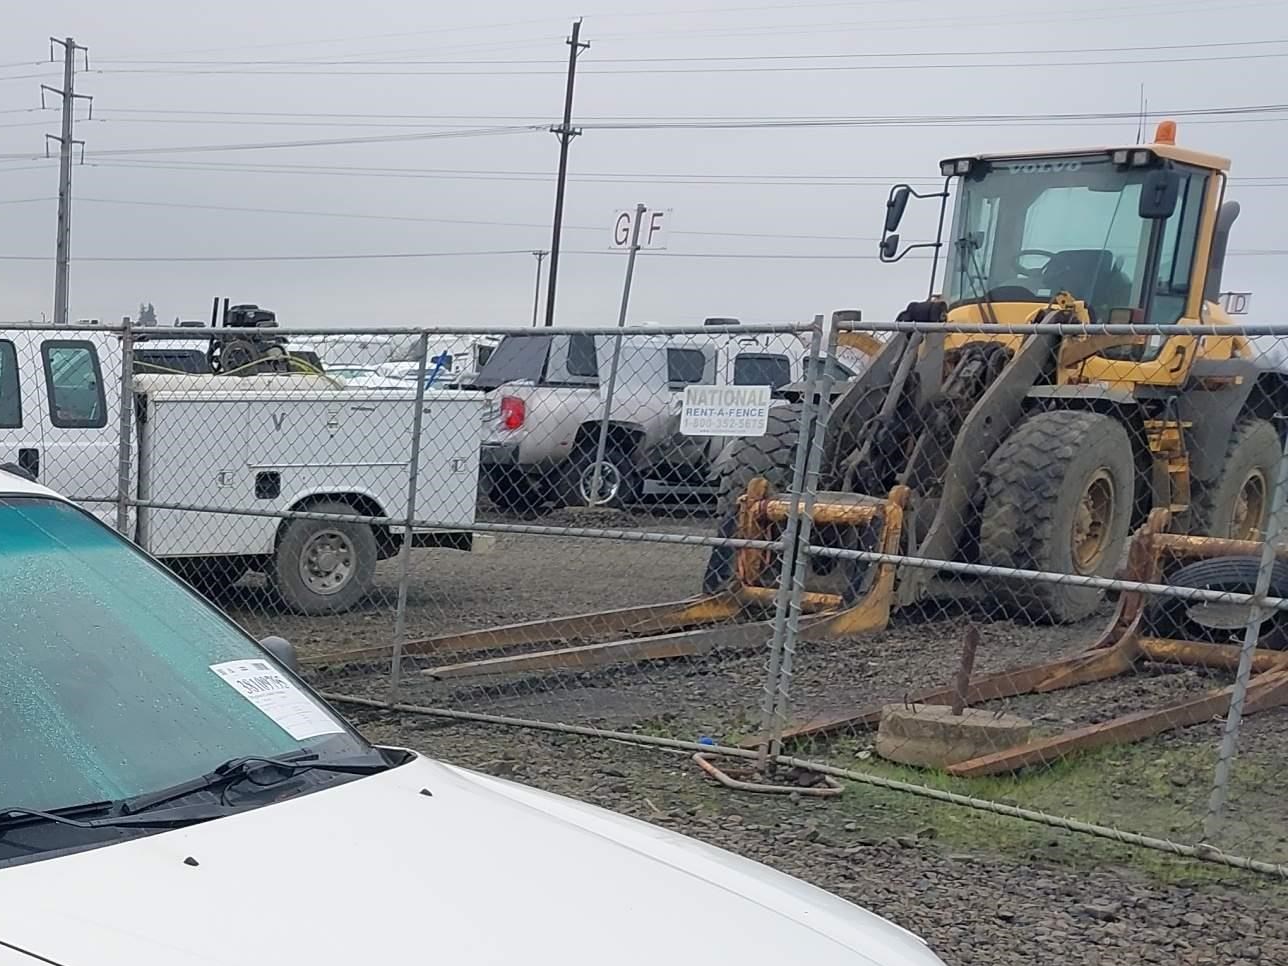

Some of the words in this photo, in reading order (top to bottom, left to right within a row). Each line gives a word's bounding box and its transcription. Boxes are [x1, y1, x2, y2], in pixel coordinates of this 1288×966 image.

[1009, 161, 1080, 174] VOLVO
[615, 212, 630, 245] G
[647, 212, 664, 245] F
[686, 388, 768, 407] NATIONAL
[686, 407, 765, 417] RENT-A-FENCE
